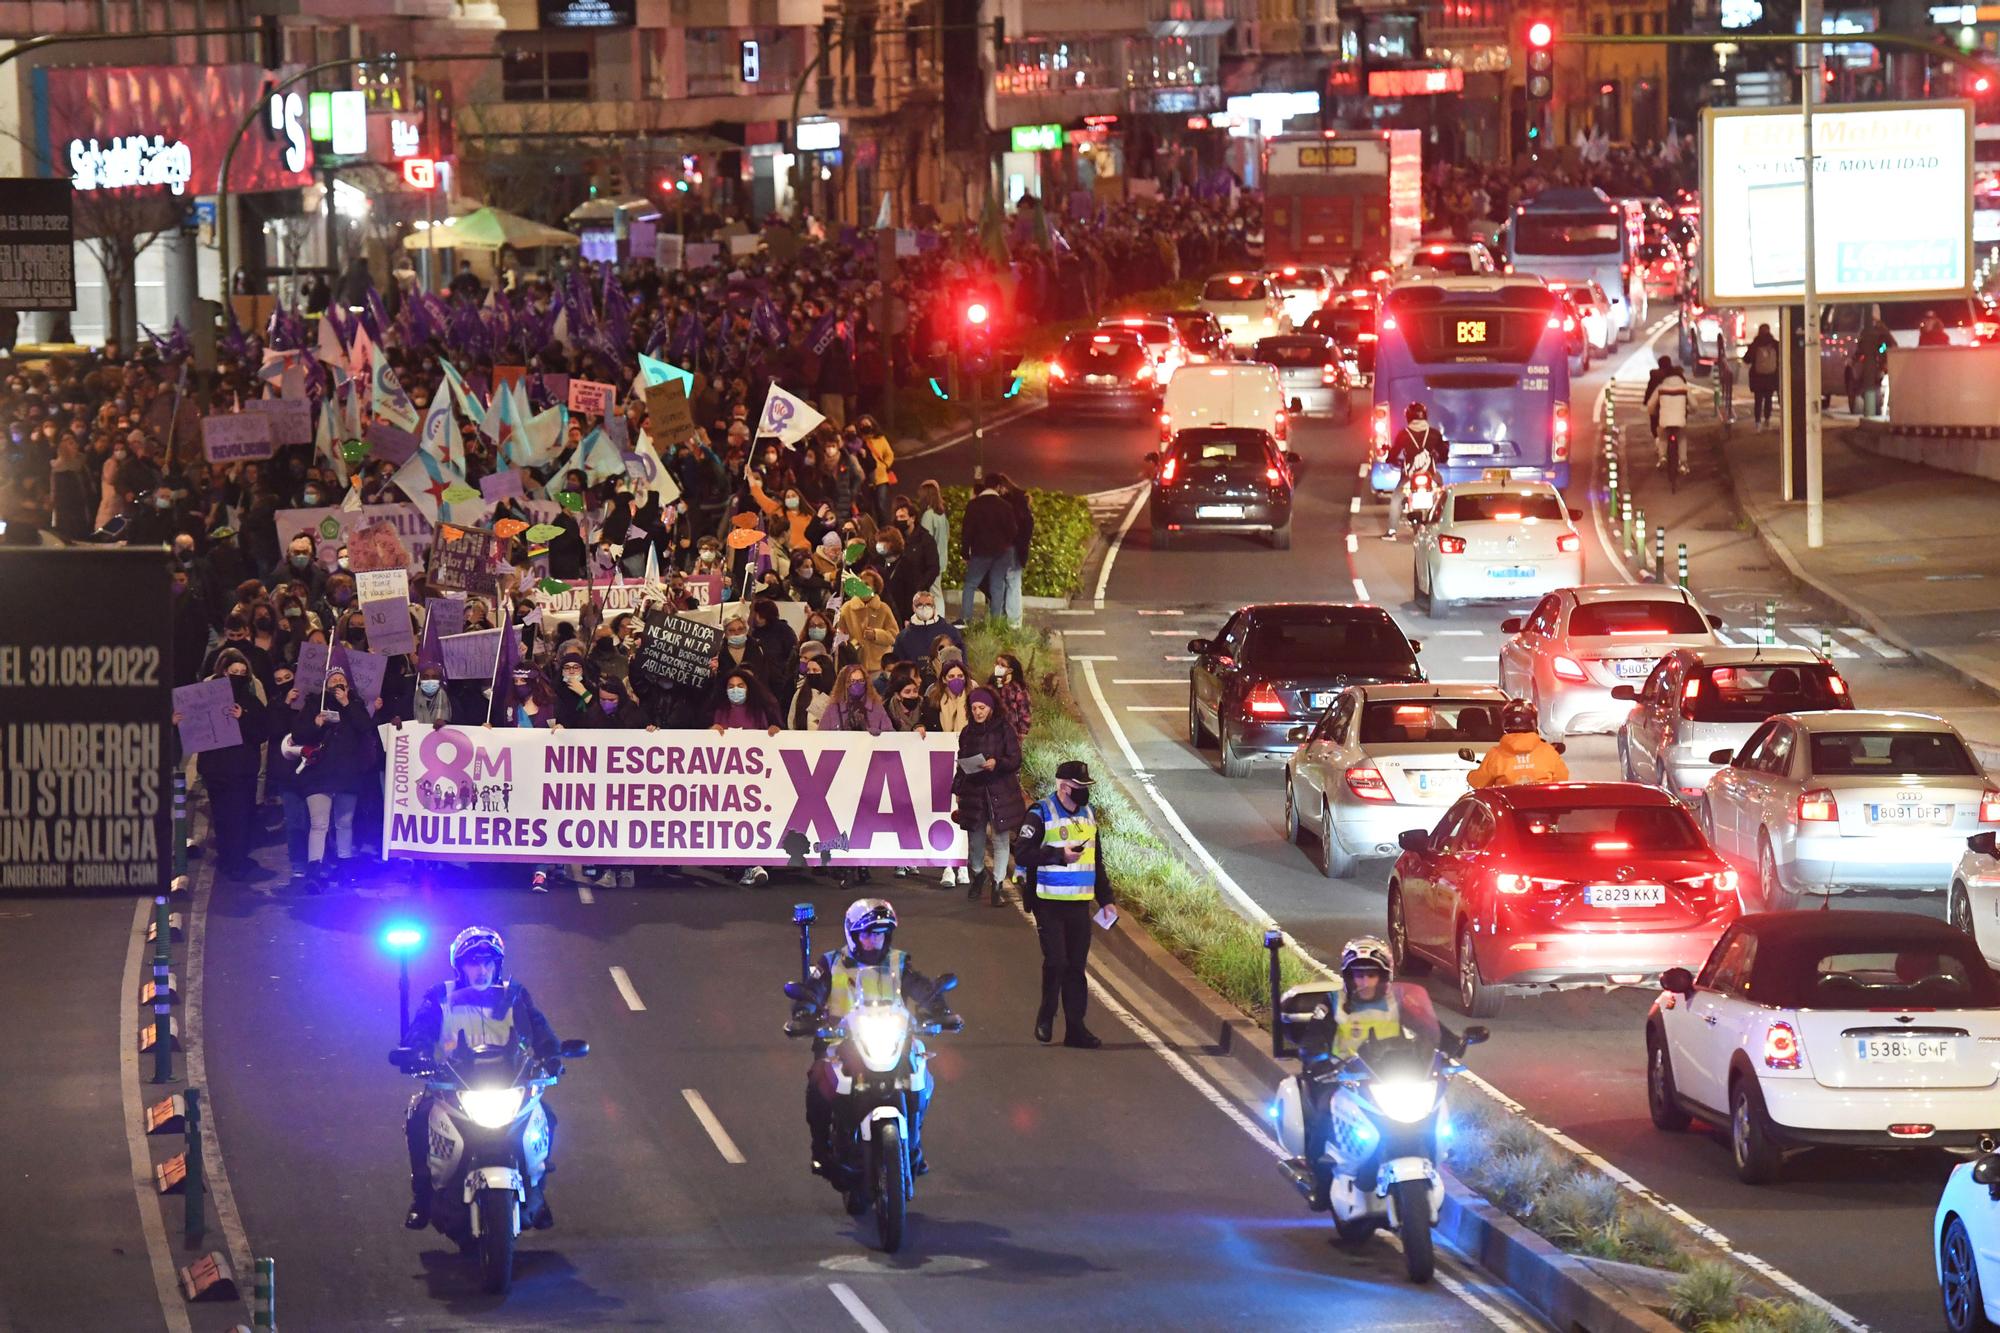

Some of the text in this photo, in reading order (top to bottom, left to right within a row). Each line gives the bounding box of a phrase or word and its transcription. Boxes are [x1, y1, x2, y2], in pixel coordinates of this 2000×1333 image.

[1839, 155, 1940, 173] MOVILIDAD
[647, 624, 662, 639] NI
[684, 638, 696, 649] NI
[695, 640, 711, 654] IR
[663, 615, 715, 642] NI TU ROPA
[643, 647, 660, 659] SON
[660, 653, 694, 672] RAZONES
[650, 639, 673, 654] SOLA
[0, 646, 160, 686] EL 31.03.2022
[641, 659, 705, 689] ABUSAR DE TI
[1621, 664, 1649, 674] 5805
[8, 723, 160, 771] LINDBERGH
[544, 745, 773, 779] NIN ESCRAVAS,
[36, 769, 160, 817] STORIES
[396, 797, 409, 808] A
[541, 782, 597, 811] NIN
[775, 748, 956, 852] XA!
[1880, 807, 1942, 819] 8091 DFP
[54, 818, 159, 862] GALICIA
[390, 813, 773, 850] MULLERES CON DEREITOS
[1595, 888, 1660, 902] 2829 KKX
